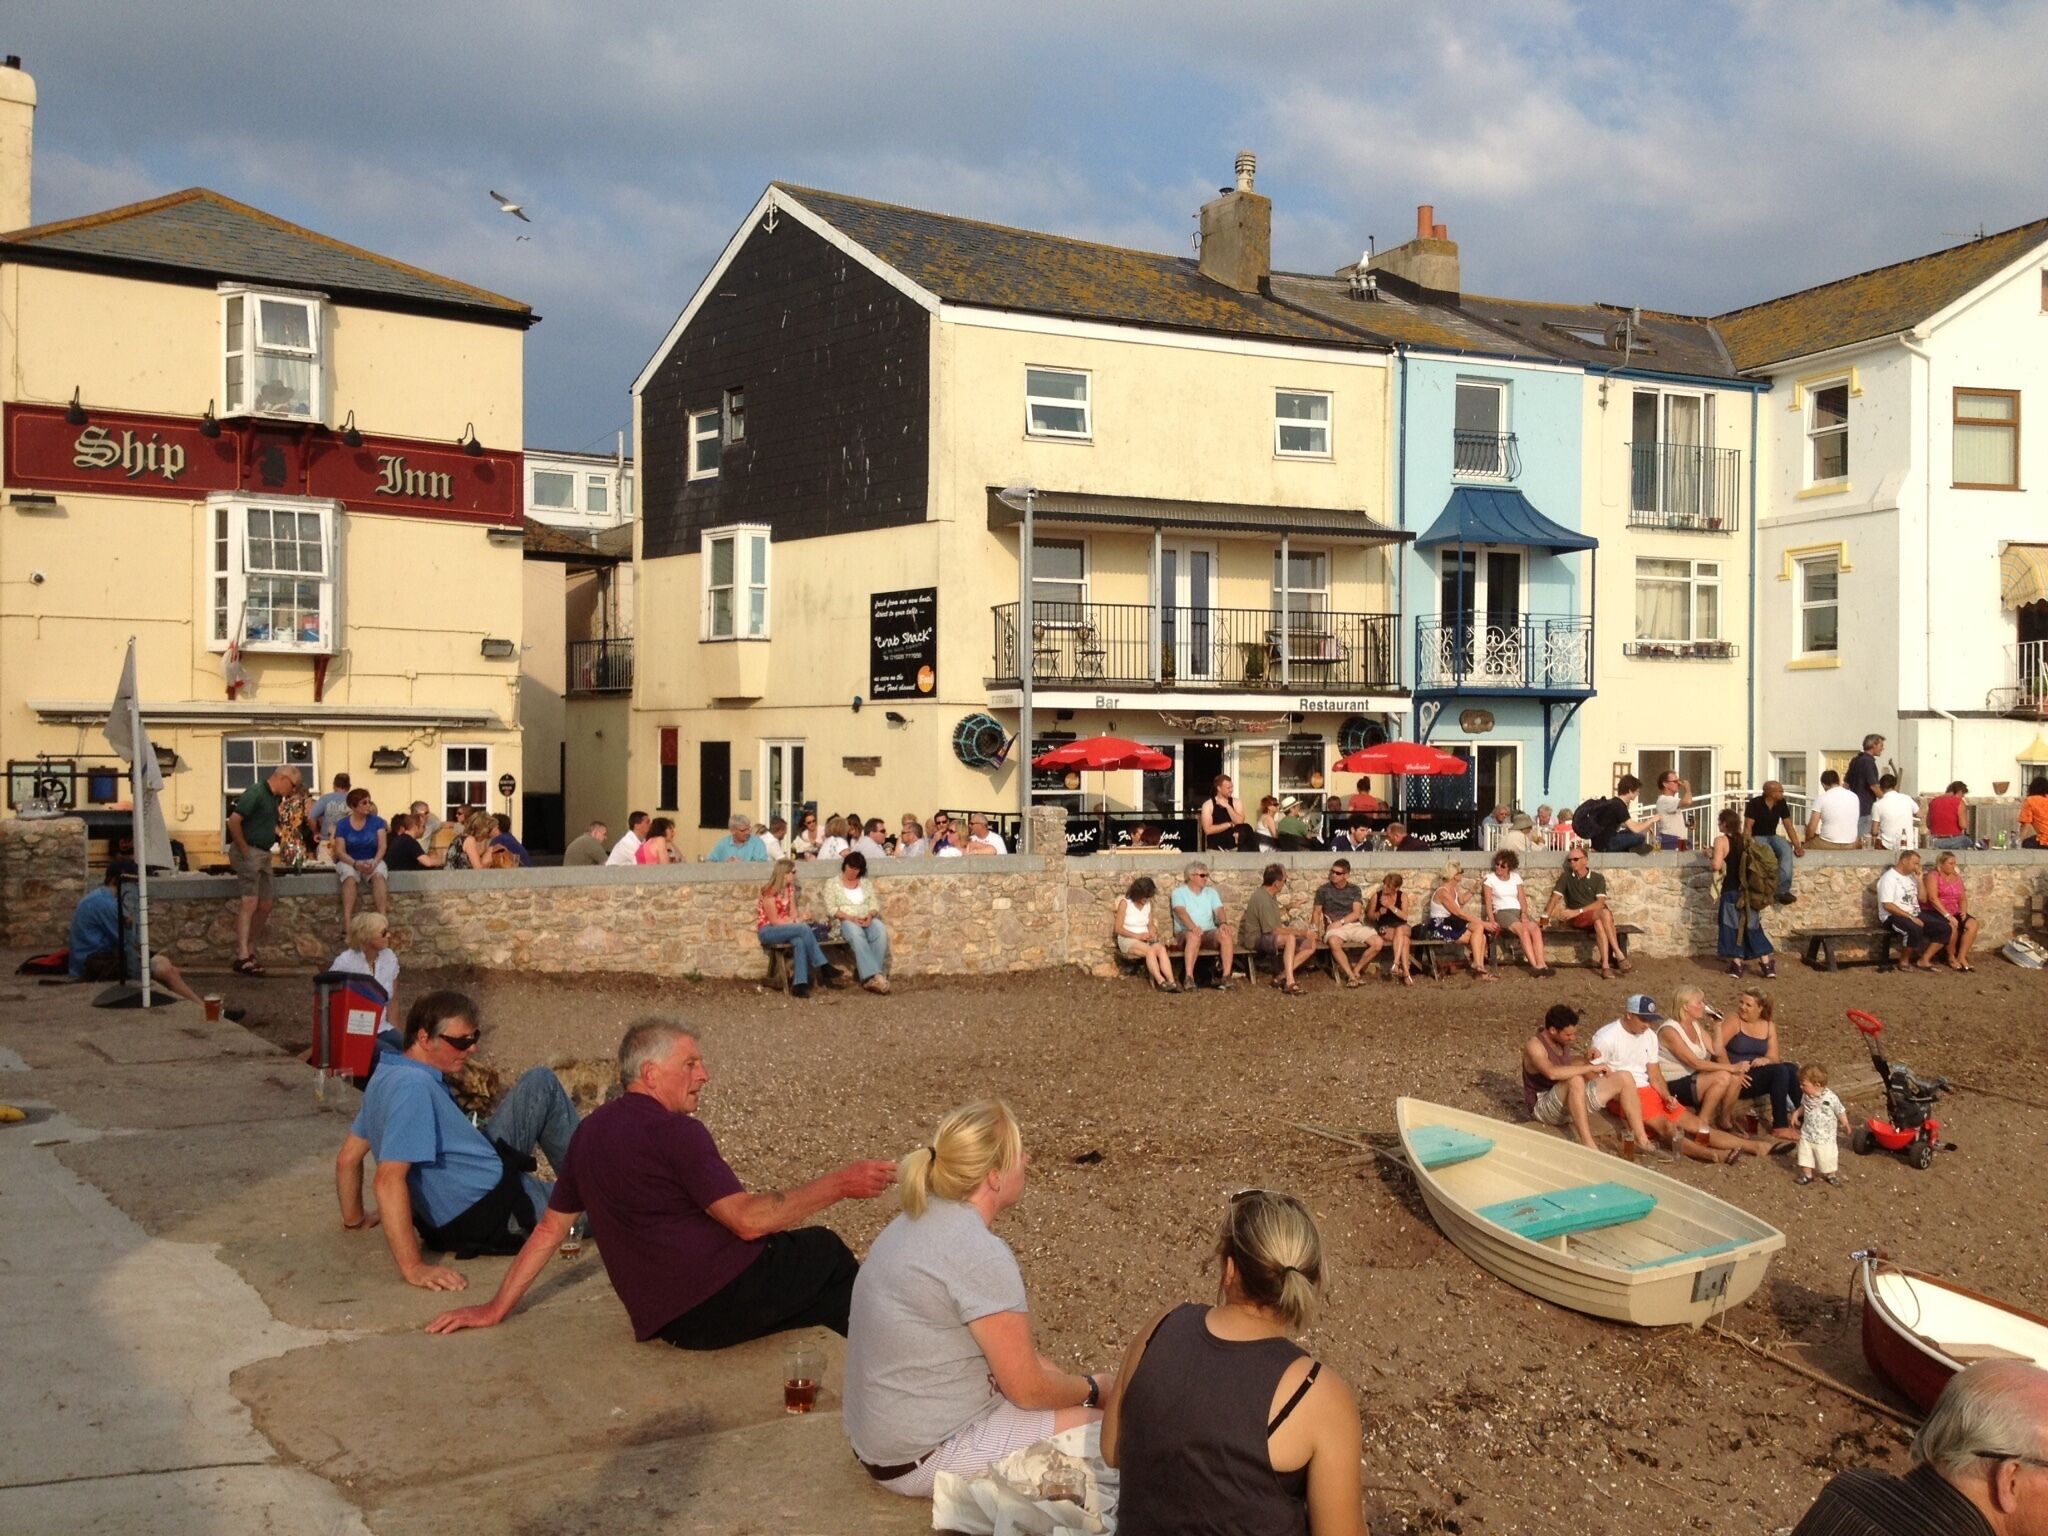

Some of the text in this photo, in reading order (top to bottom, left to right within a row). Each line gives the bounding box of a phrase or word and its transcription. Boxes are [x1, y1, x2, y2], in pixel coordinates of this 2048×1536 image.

[73, 425, 453, 499] Ship Inn
[1096, 695, 1120, 709] Bar
[1300, 698, 1370, 711] Restaurant
